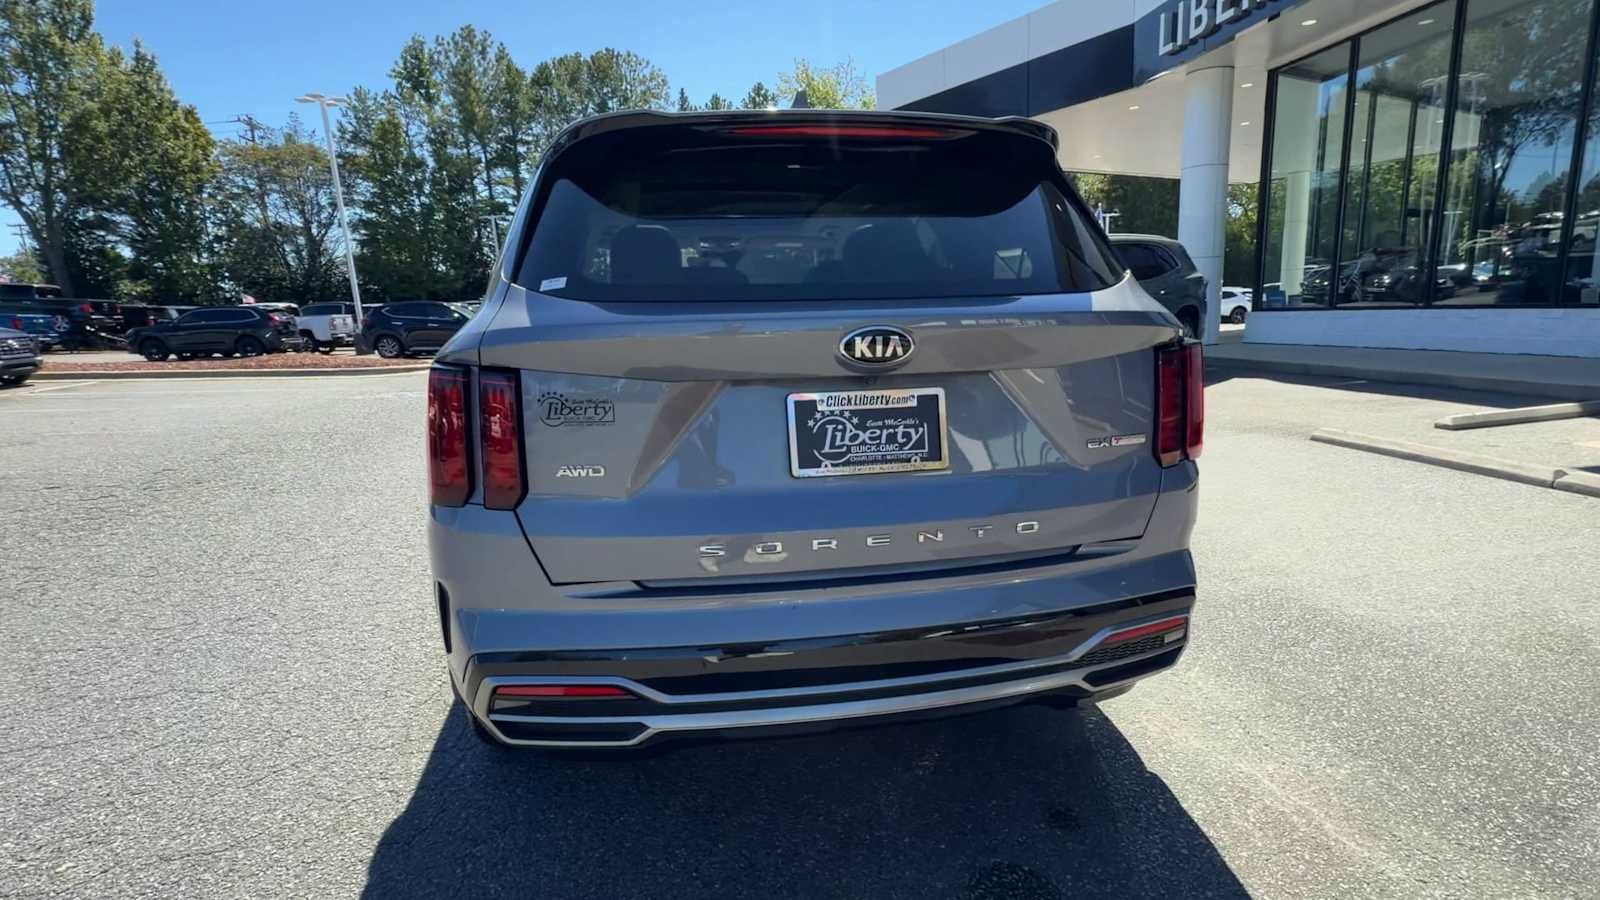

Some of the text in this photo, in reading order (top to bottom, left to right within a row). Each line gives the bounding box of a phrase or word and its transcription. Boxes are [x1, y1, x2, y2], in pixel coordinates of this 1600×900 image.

[1159, 0, 1262, 56] LIBE
[854, 335, 904, 358] KIA
[545, 401, 612, 421] Liberty
[826, 393, 910, 408] ClickLiberty.com
[821, 423, 924, 453] Liberty
[556, 465, 605, 477] AWD
[699, 521, 1040, 557] SORENTO
